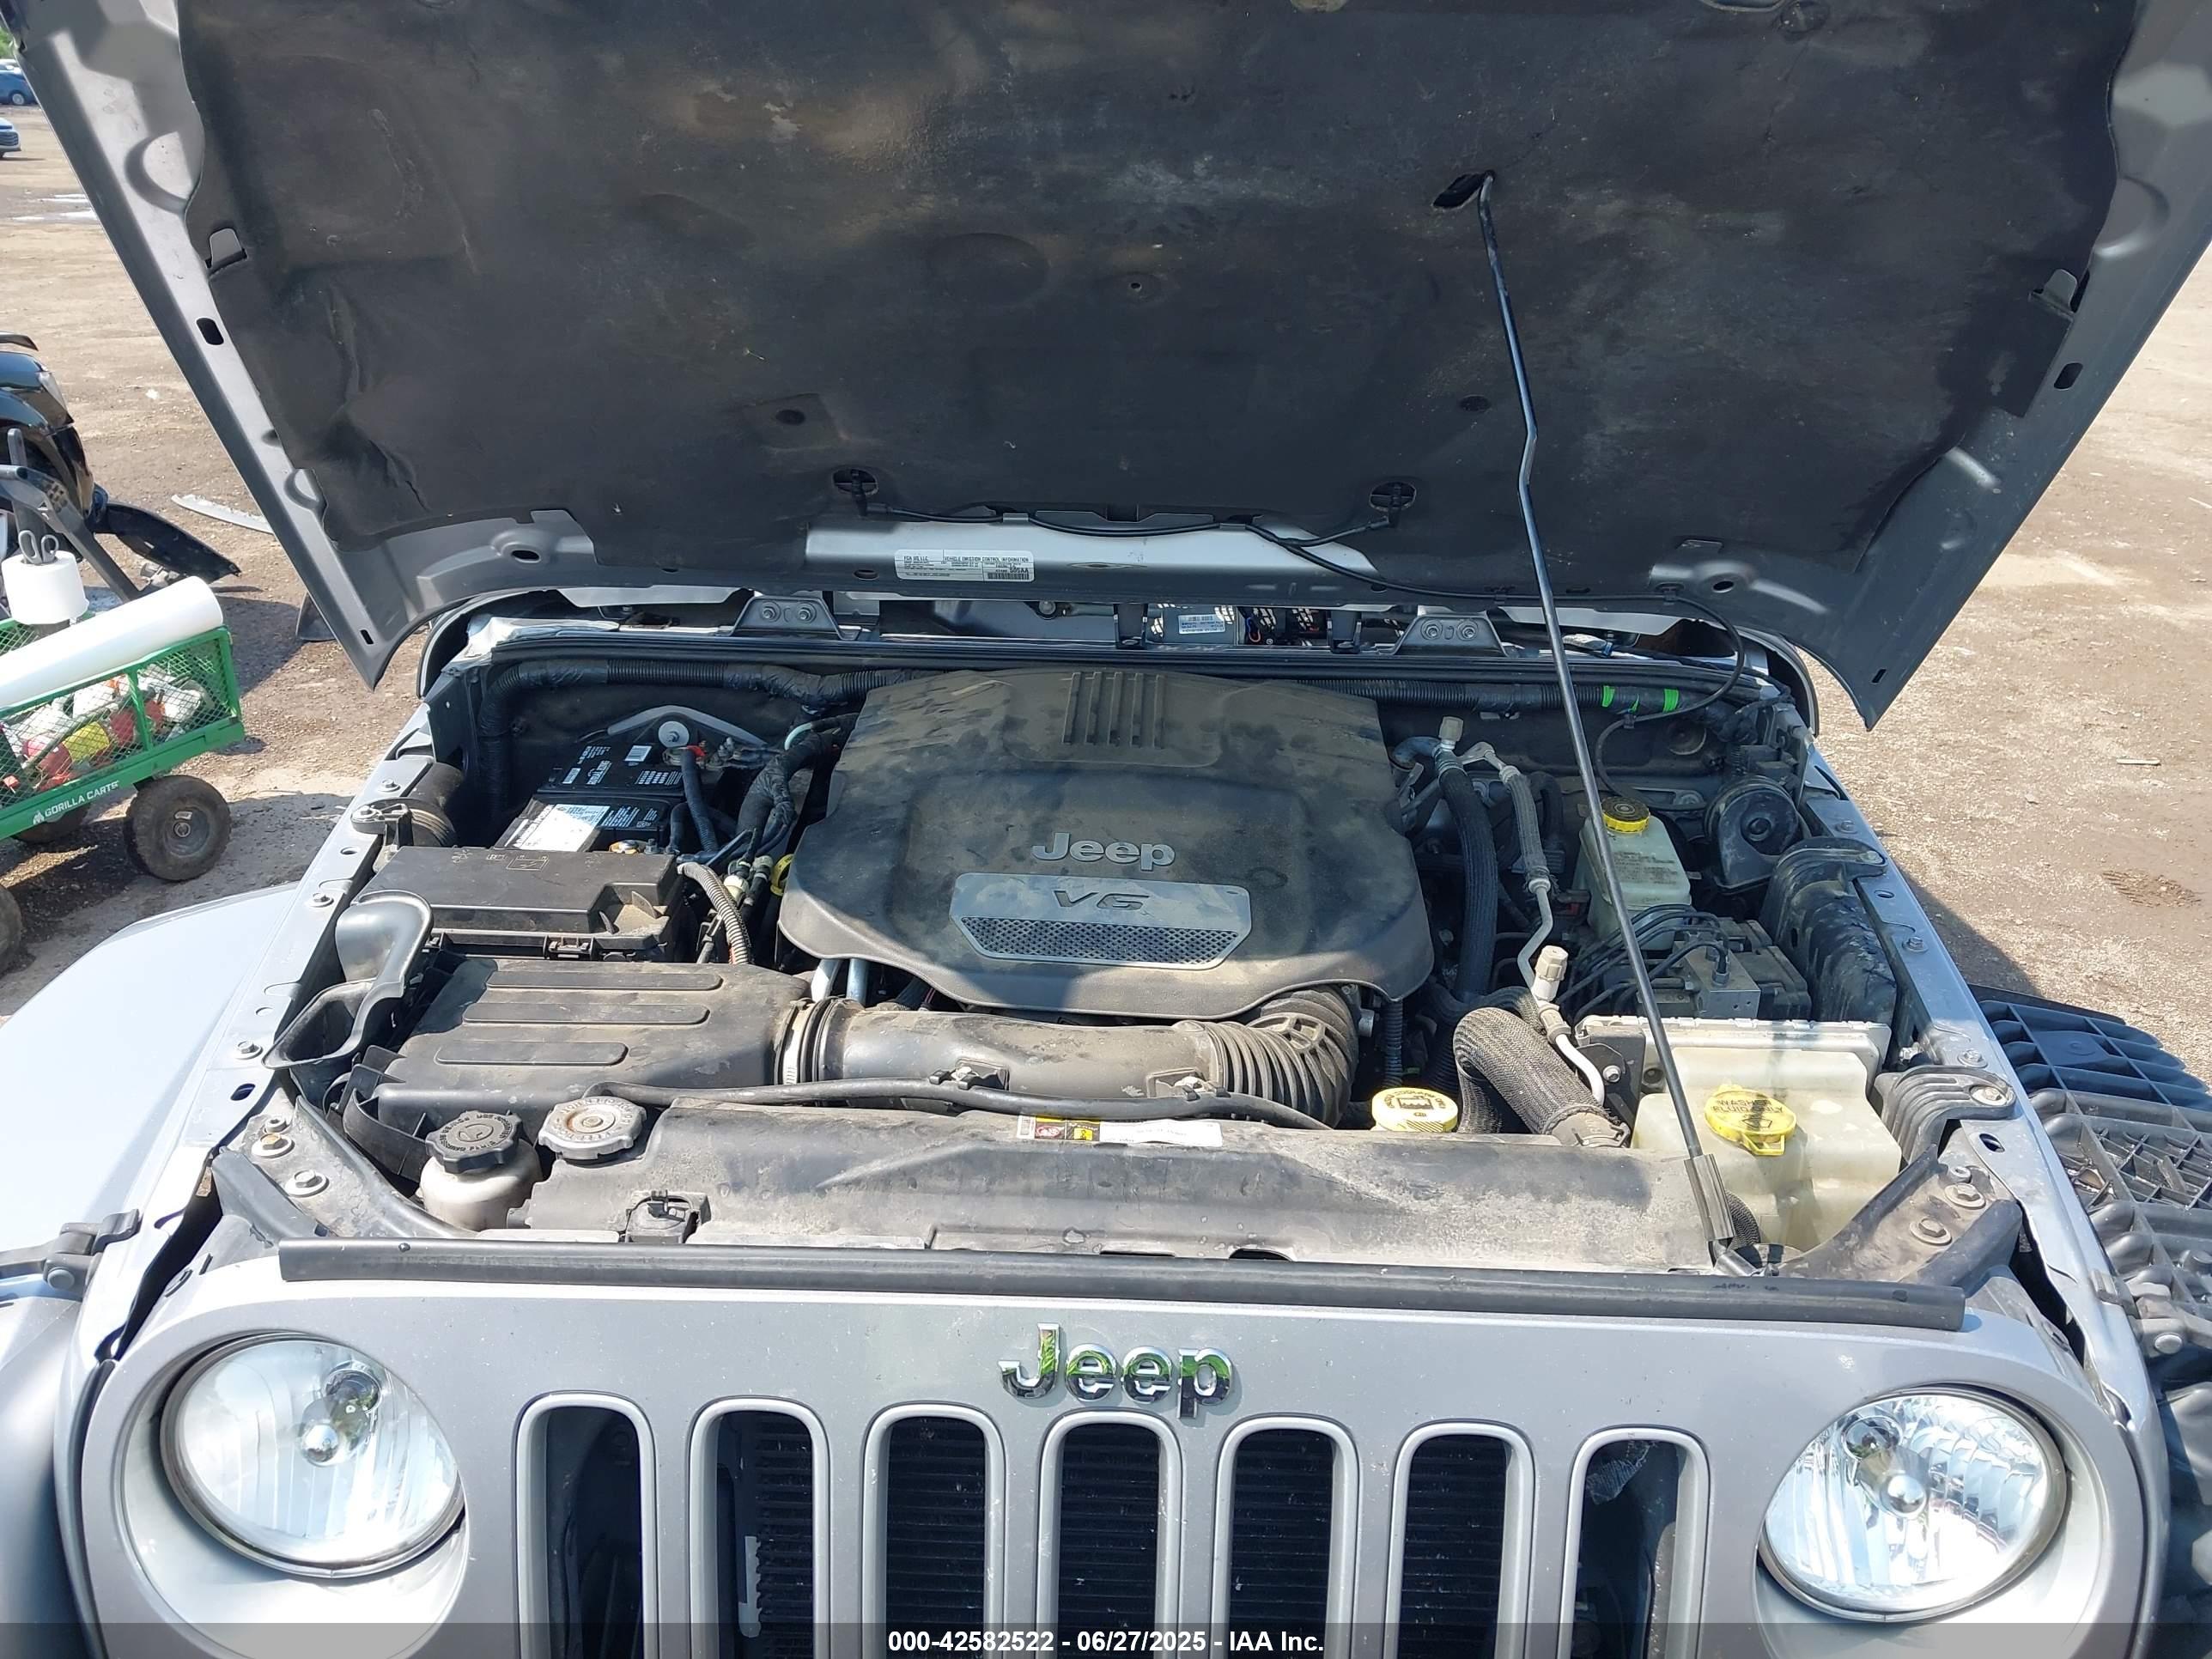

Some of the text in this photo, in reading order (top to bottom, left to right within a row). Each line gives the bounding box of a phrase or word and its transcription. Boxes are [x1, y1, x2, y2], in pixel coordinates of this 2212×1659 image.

[45, 781, 119, 818] GORILLA CARTS
[1031, 831, 1176, 872] Jeep
[1053, 890, 1151, 911] V6
[1711, 1105, 1784, 1114] FLUID ONLY
[997, 1322, 1235, 1420] Jeep
